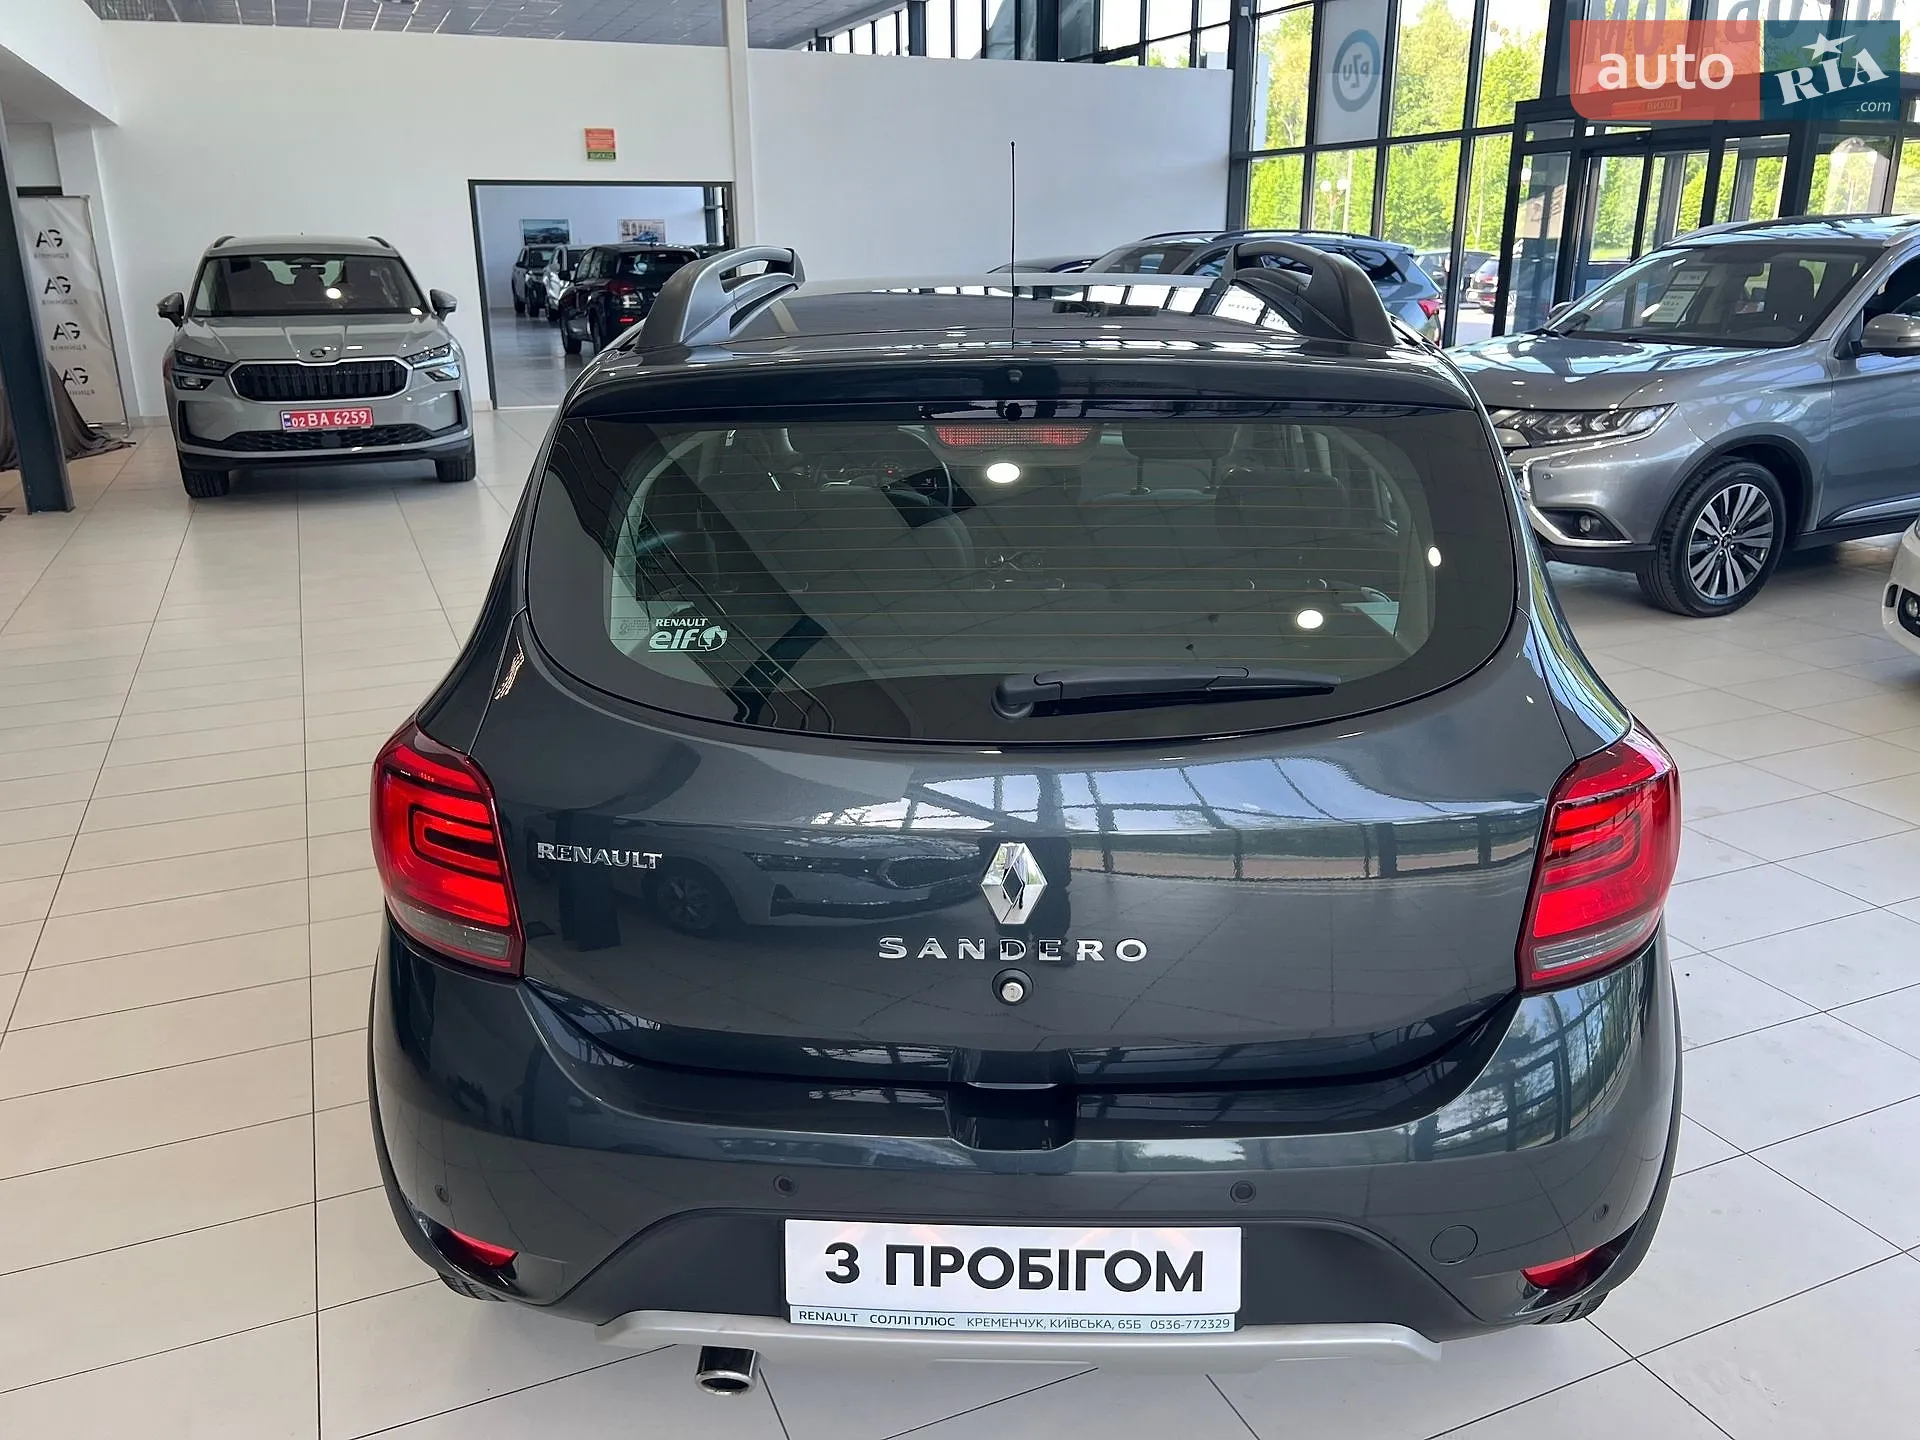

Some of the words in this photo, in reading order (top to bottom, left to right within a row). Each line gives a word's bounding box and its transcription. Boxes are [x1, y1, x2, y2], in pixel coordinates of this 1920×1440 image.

[36, 229, 63, 248] AG
[44, 276, 71, 294] AG
[53, 322, 80, 340] AG
[292, 417, 306, 427] 02
[308, 413, 329, 426] BA
[334, 411, 367, 424] 6259
[655, 618, 708, 627] RENAULT
[649, 628, 699, 649] elf
[537, 842, 663, 870] RENAULT
[878, 937, 1148, 963] SANDERO
[885, 1244, 1204, 1293] ПРОБІГОМ
[799, 1310, 858, 1323] RENAULT
[869, 1314, 910, 1325] СОЛЛІ
[914, 1316, 956, 1327] ПЛЮС
[967, 1317, 1046, 1330] КРЕМЕНЧУК,
[1050, 1316, 1115, 1331] КИЇВСЬКА,
[1118, 1319, 1142, 1330] 65Б
[1150, 1318, 1230, 1330] 0536-772329
